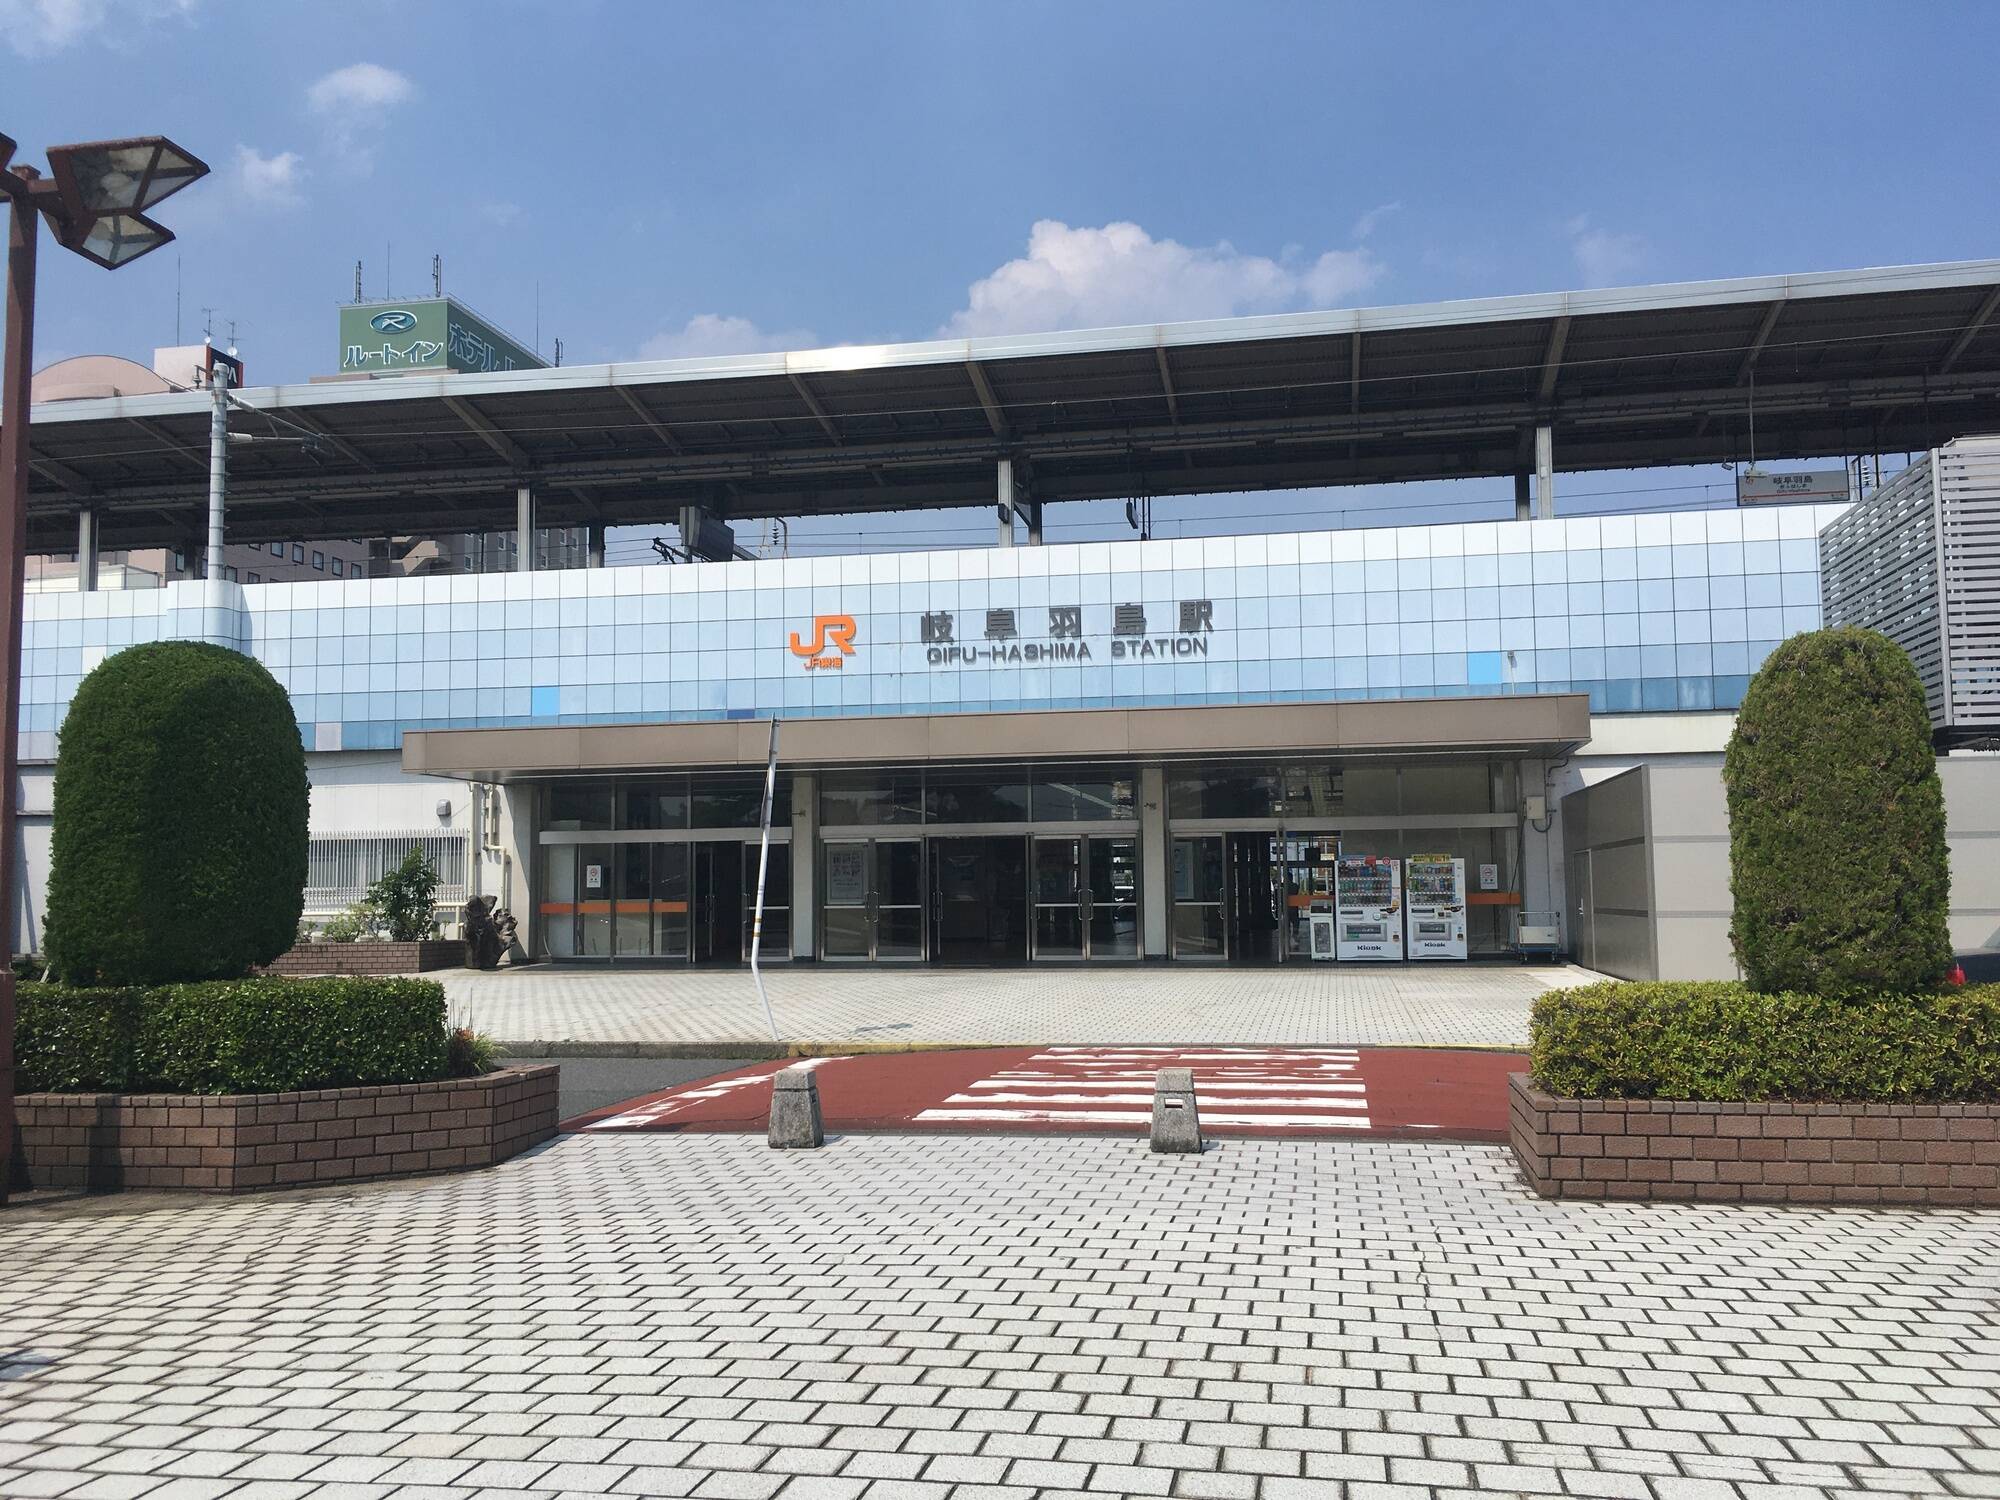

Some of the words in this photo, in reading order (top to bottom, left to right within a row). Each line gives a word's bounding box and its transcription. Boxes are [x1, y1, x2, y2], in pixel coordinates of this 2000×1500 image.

[343, 341, 444, 368] ルートイン
[790, 615, 857, 656] JR
[920, 599, 1214, 645] 岐阜羽島駅
[927, 641, 1093, 666] GIFU-HASHIMA
[1111, 637, 1208, 659] STATION
